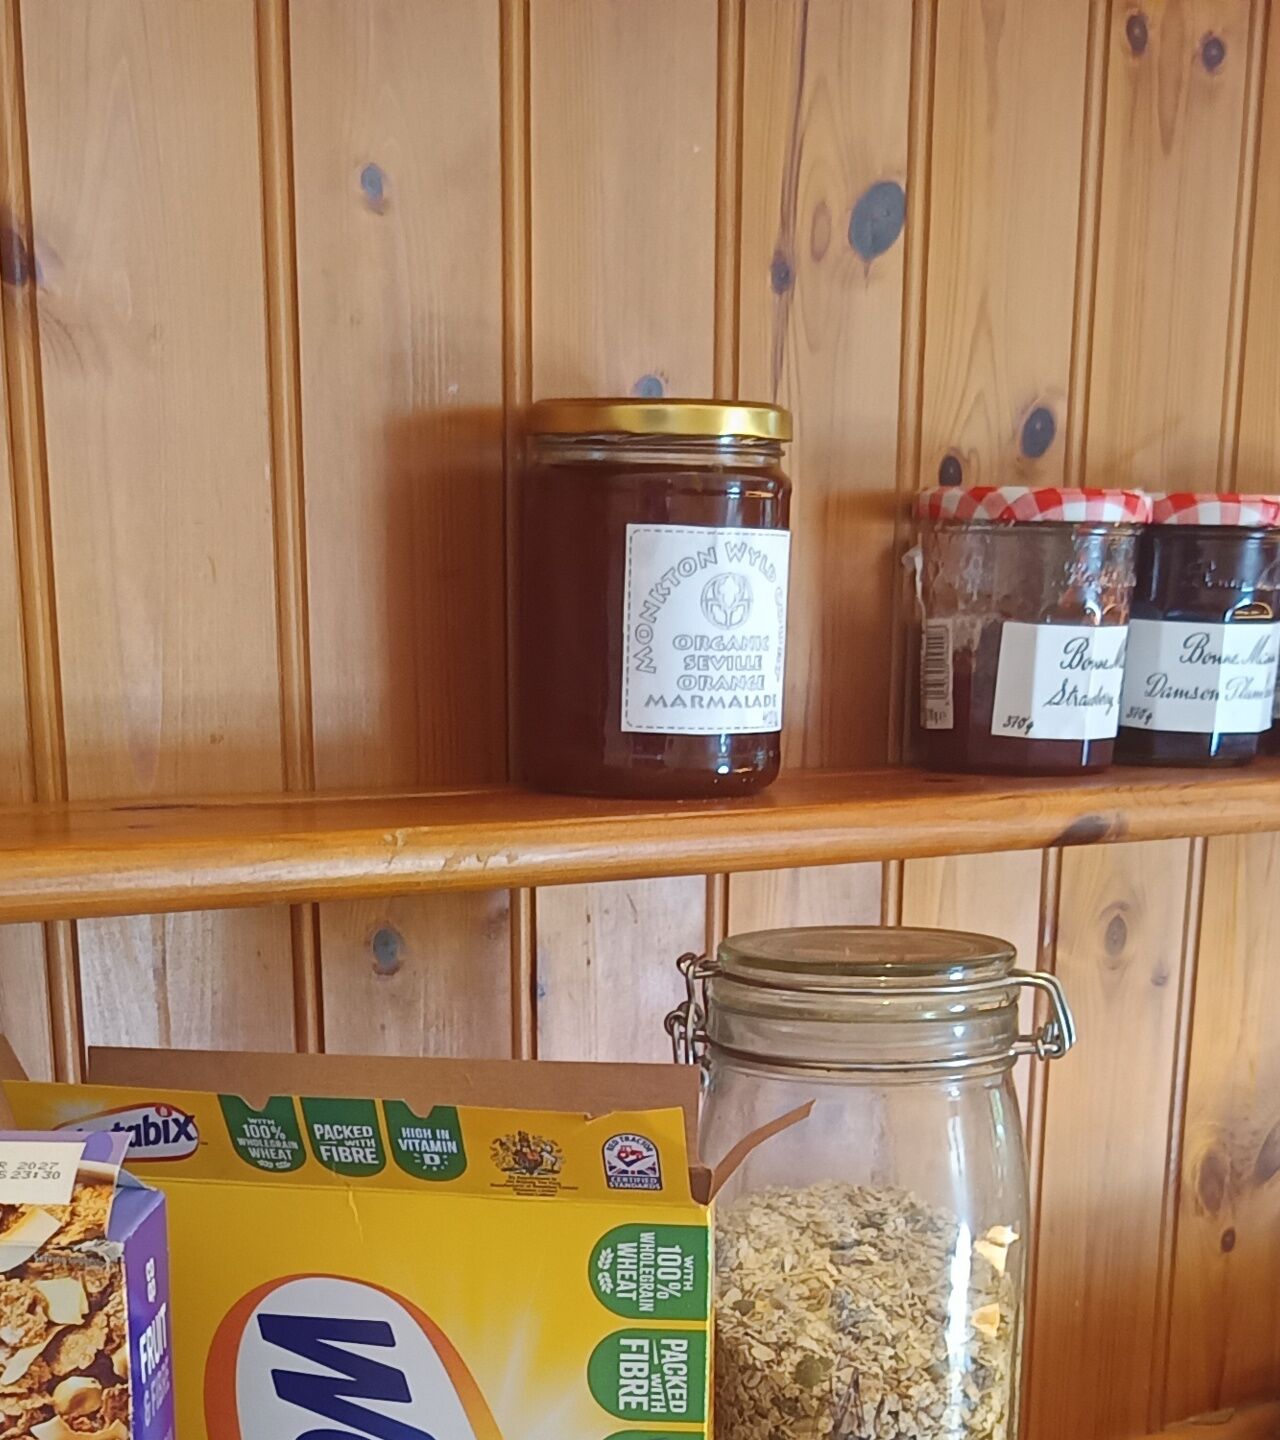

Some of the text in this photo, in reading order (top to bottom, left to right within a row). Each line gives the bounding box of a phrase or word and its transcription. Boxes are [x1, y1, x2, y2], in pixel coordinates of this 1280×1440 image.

[633, 547, 718, 674] MONKTON
[725, 541, 776, 583] WYLD
[672, 634, 770, 651] ORGANIC
[1179, 632, 1240, 665] Bonne
[683, 655, 762, 671] SEVILLE
[677, 674, 765, 691] ORANGE
[1144, 672, 1219, 700] Damson
[242, 1124, 286, 1139] 100%
[314, 1124, 373, 1140] PACKED
[401, 1127, 450, 1140] HIGH IN
[345, 1138, 376, 1148] WITH
[397, 1138, 457, 1153] VITAMIN
[248, 1146, 293, 1161] WHEAT
[320, 1145, 379, 1164] FIBRE
[19, 1161, 59, 1171] 2027
[616, 1242, 638, 1301] WHEAT
[639, 1232, 656, 1312] WHOLEGRAIN
[657, 1245, 682, 1298] 100%
[683, 1255, 694, 1291] WITH
[618, 1338, 650, 1411] FIBRE
[660, 1338, 689, 1413] PACKED
[650, 1373, 667, 1413] WITH
